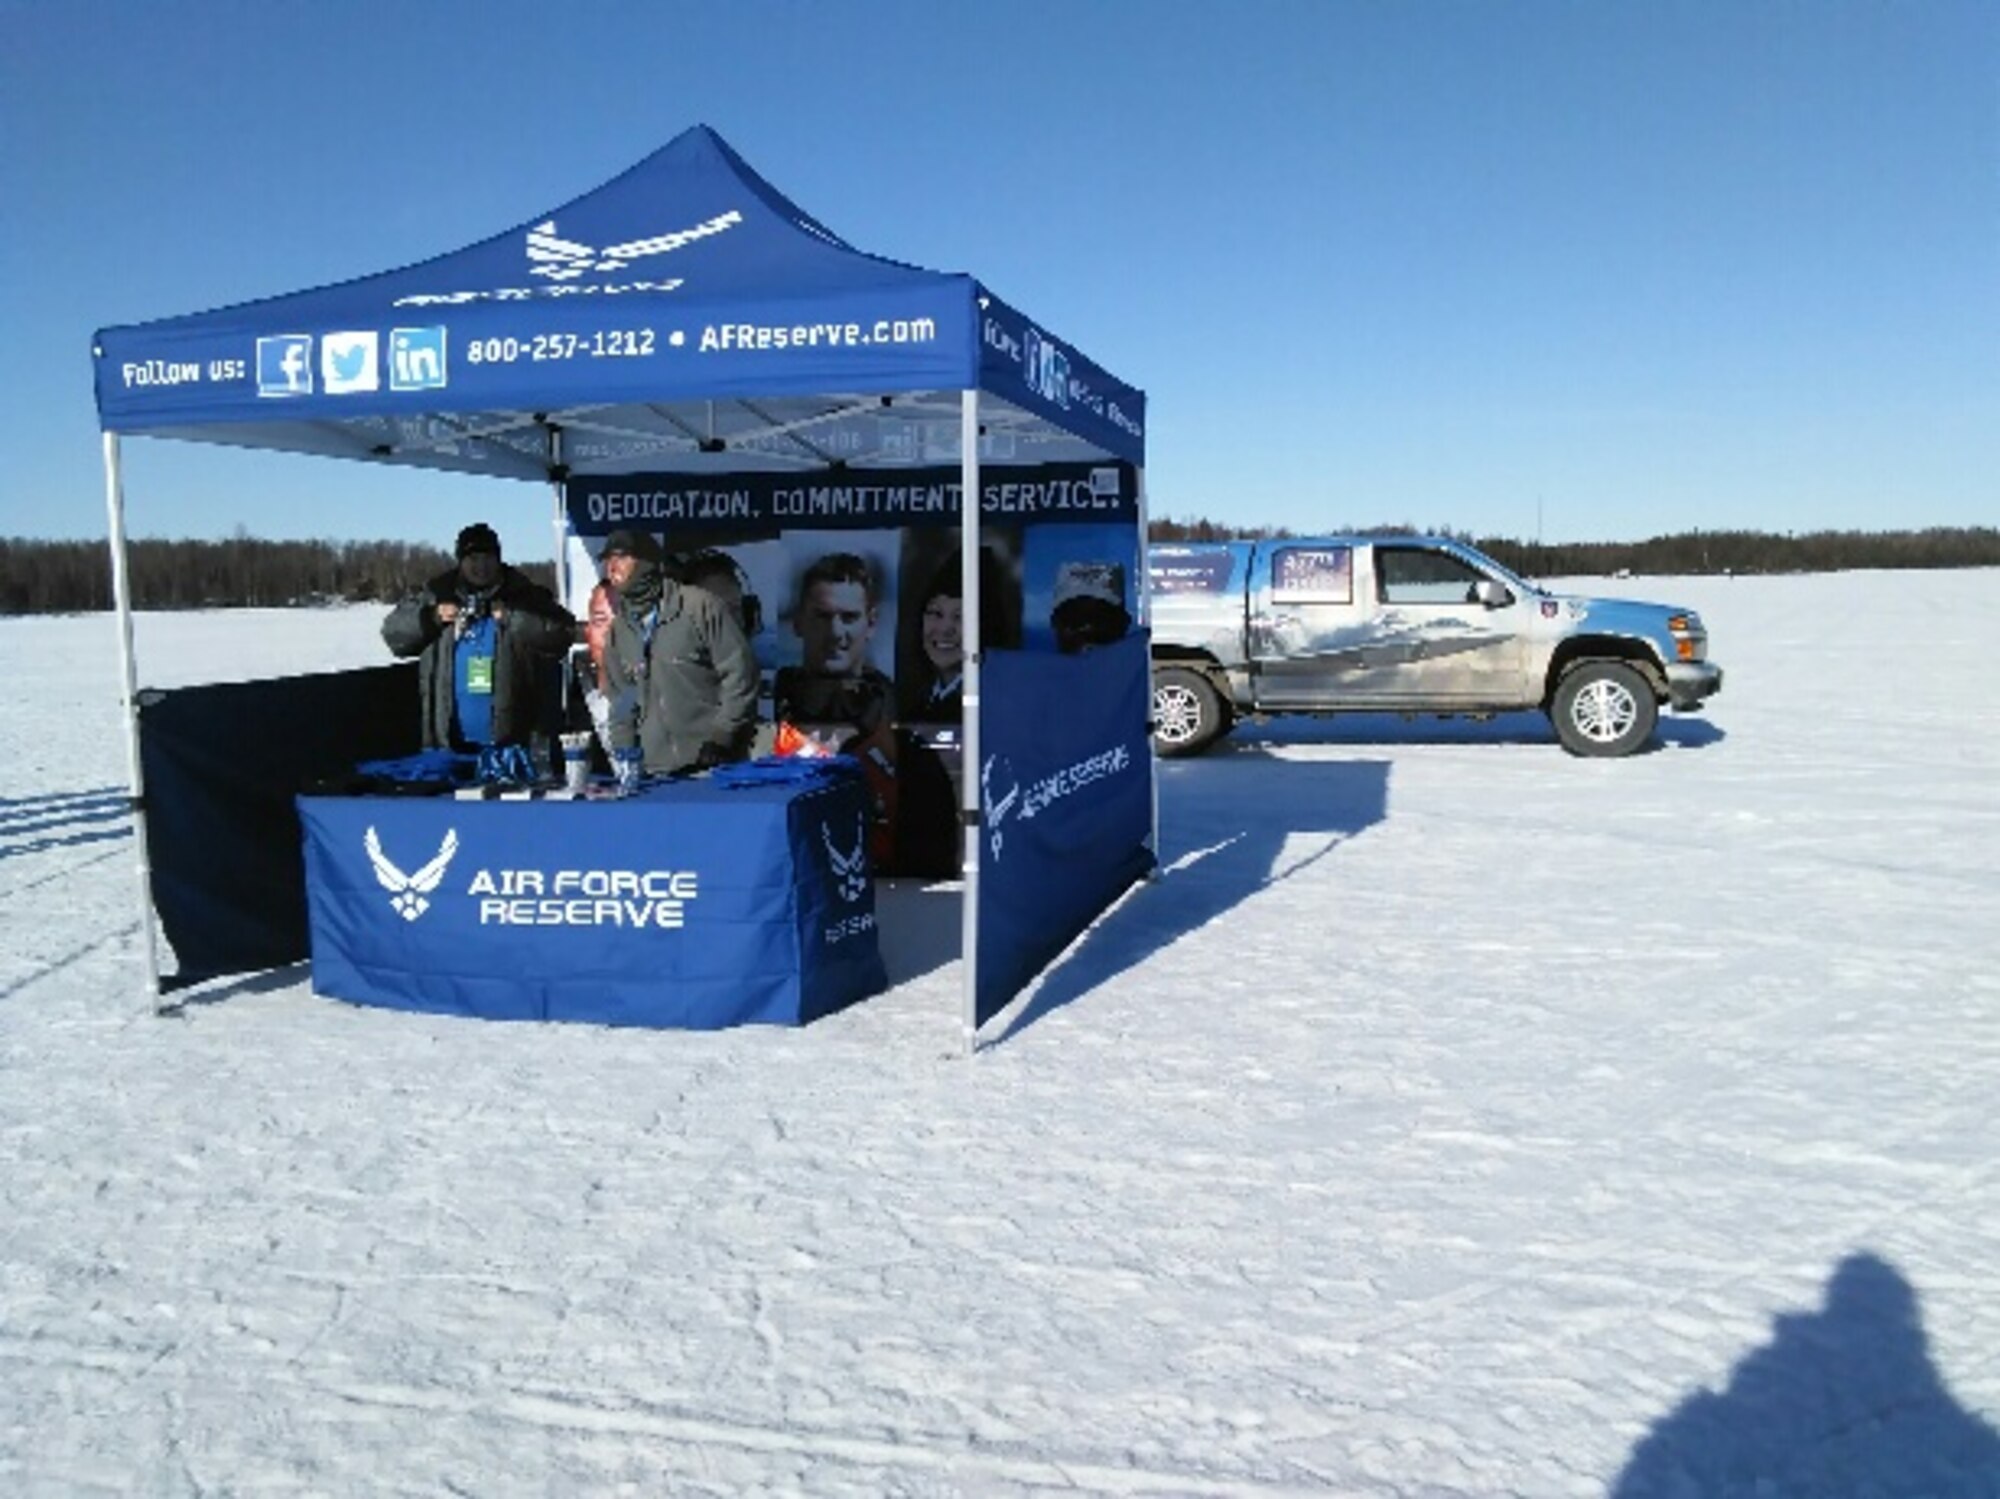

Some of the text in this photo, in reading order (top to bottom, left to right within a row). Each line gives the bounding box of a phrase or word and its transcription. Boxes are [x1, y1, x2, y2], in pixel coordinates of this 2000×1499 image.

[467, 316, 936, 365] 800-257-1212 AFReserve.com
[122, 359, 200, 388] Follow
[467, 868, 698, 901] AIR FORCE
[480, 898, 685, 929] RESERVE
